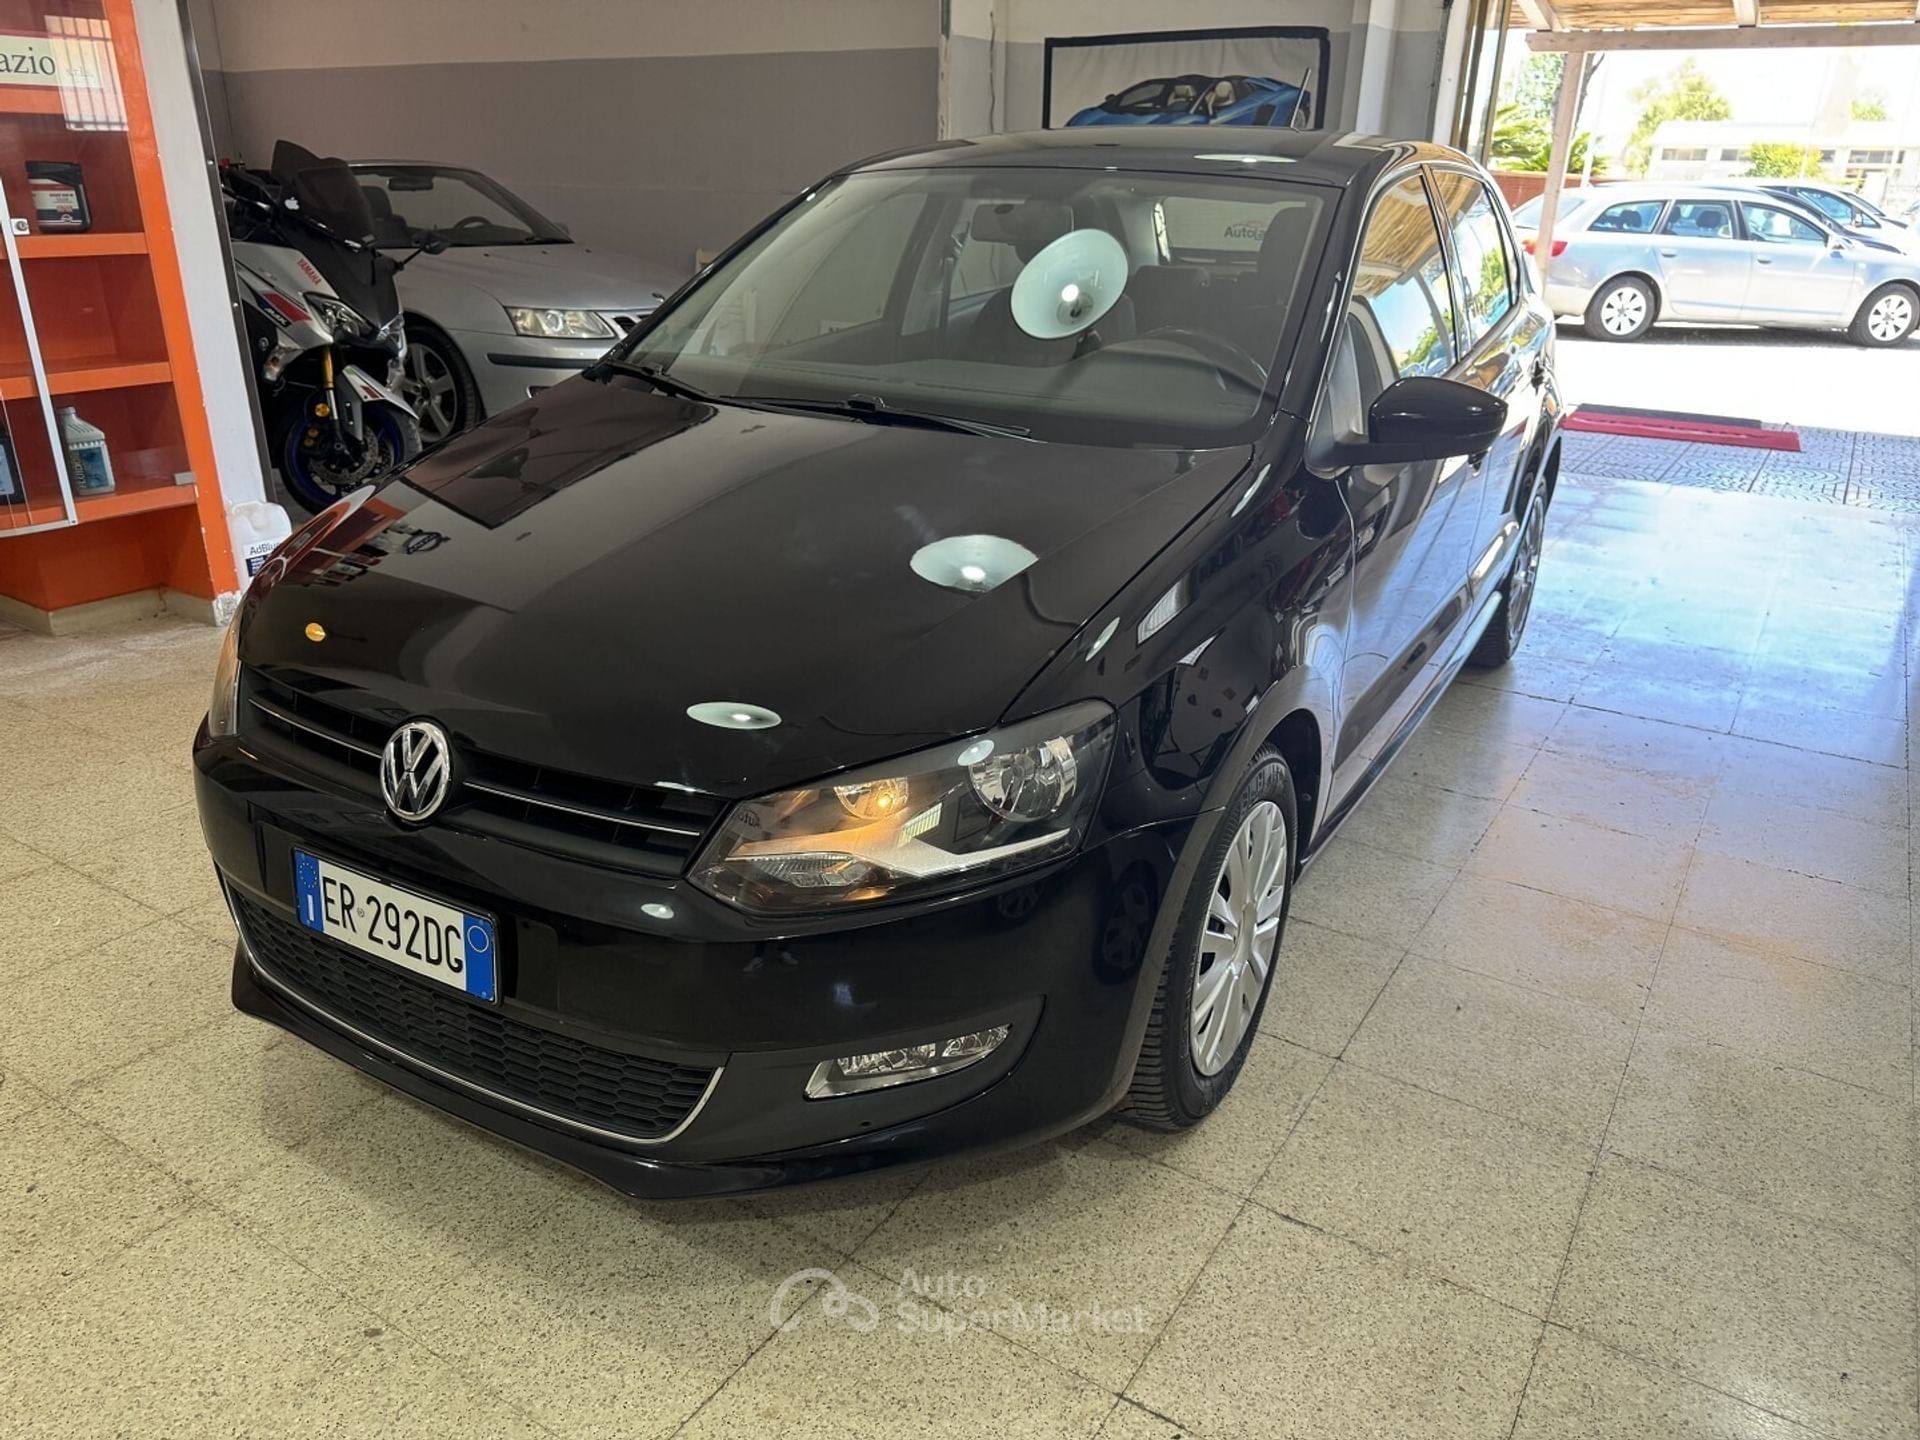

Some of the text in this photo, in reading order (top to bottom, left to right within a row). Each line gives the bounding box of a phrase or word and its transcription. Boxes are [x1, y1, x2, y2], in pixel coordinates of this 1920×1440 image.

[297, 258, 322, 285] YAMAHA
[322, 876, 464, 974] ER 292DG
